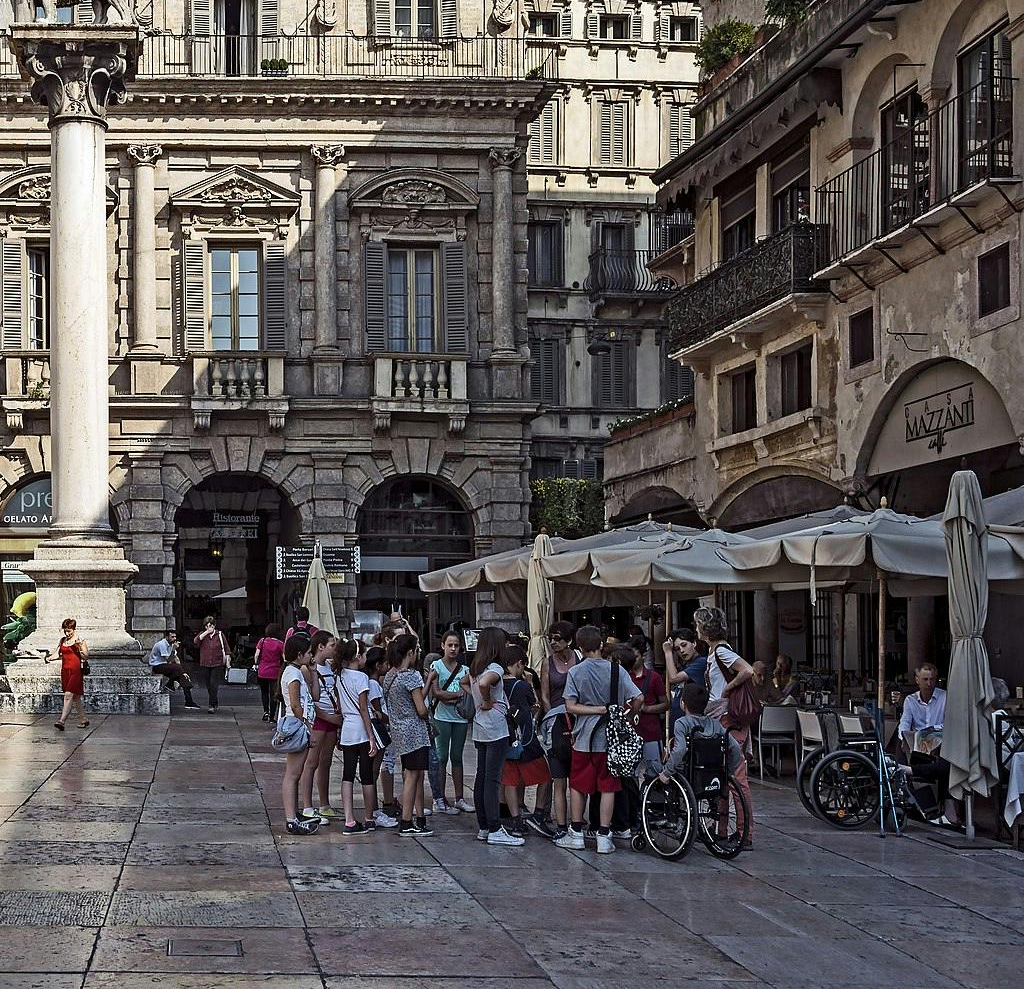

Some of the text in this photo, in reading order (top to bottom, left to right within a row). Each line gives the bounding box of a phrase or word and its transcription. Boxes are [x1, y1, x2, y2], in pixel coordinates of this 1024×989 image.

[906, 400, 974, 440] MAZZANTI
[21, 492, 53, 512] pre
[4, 515, 38, 523] GELATO
[212, 512, 260, 522] Ristorante
